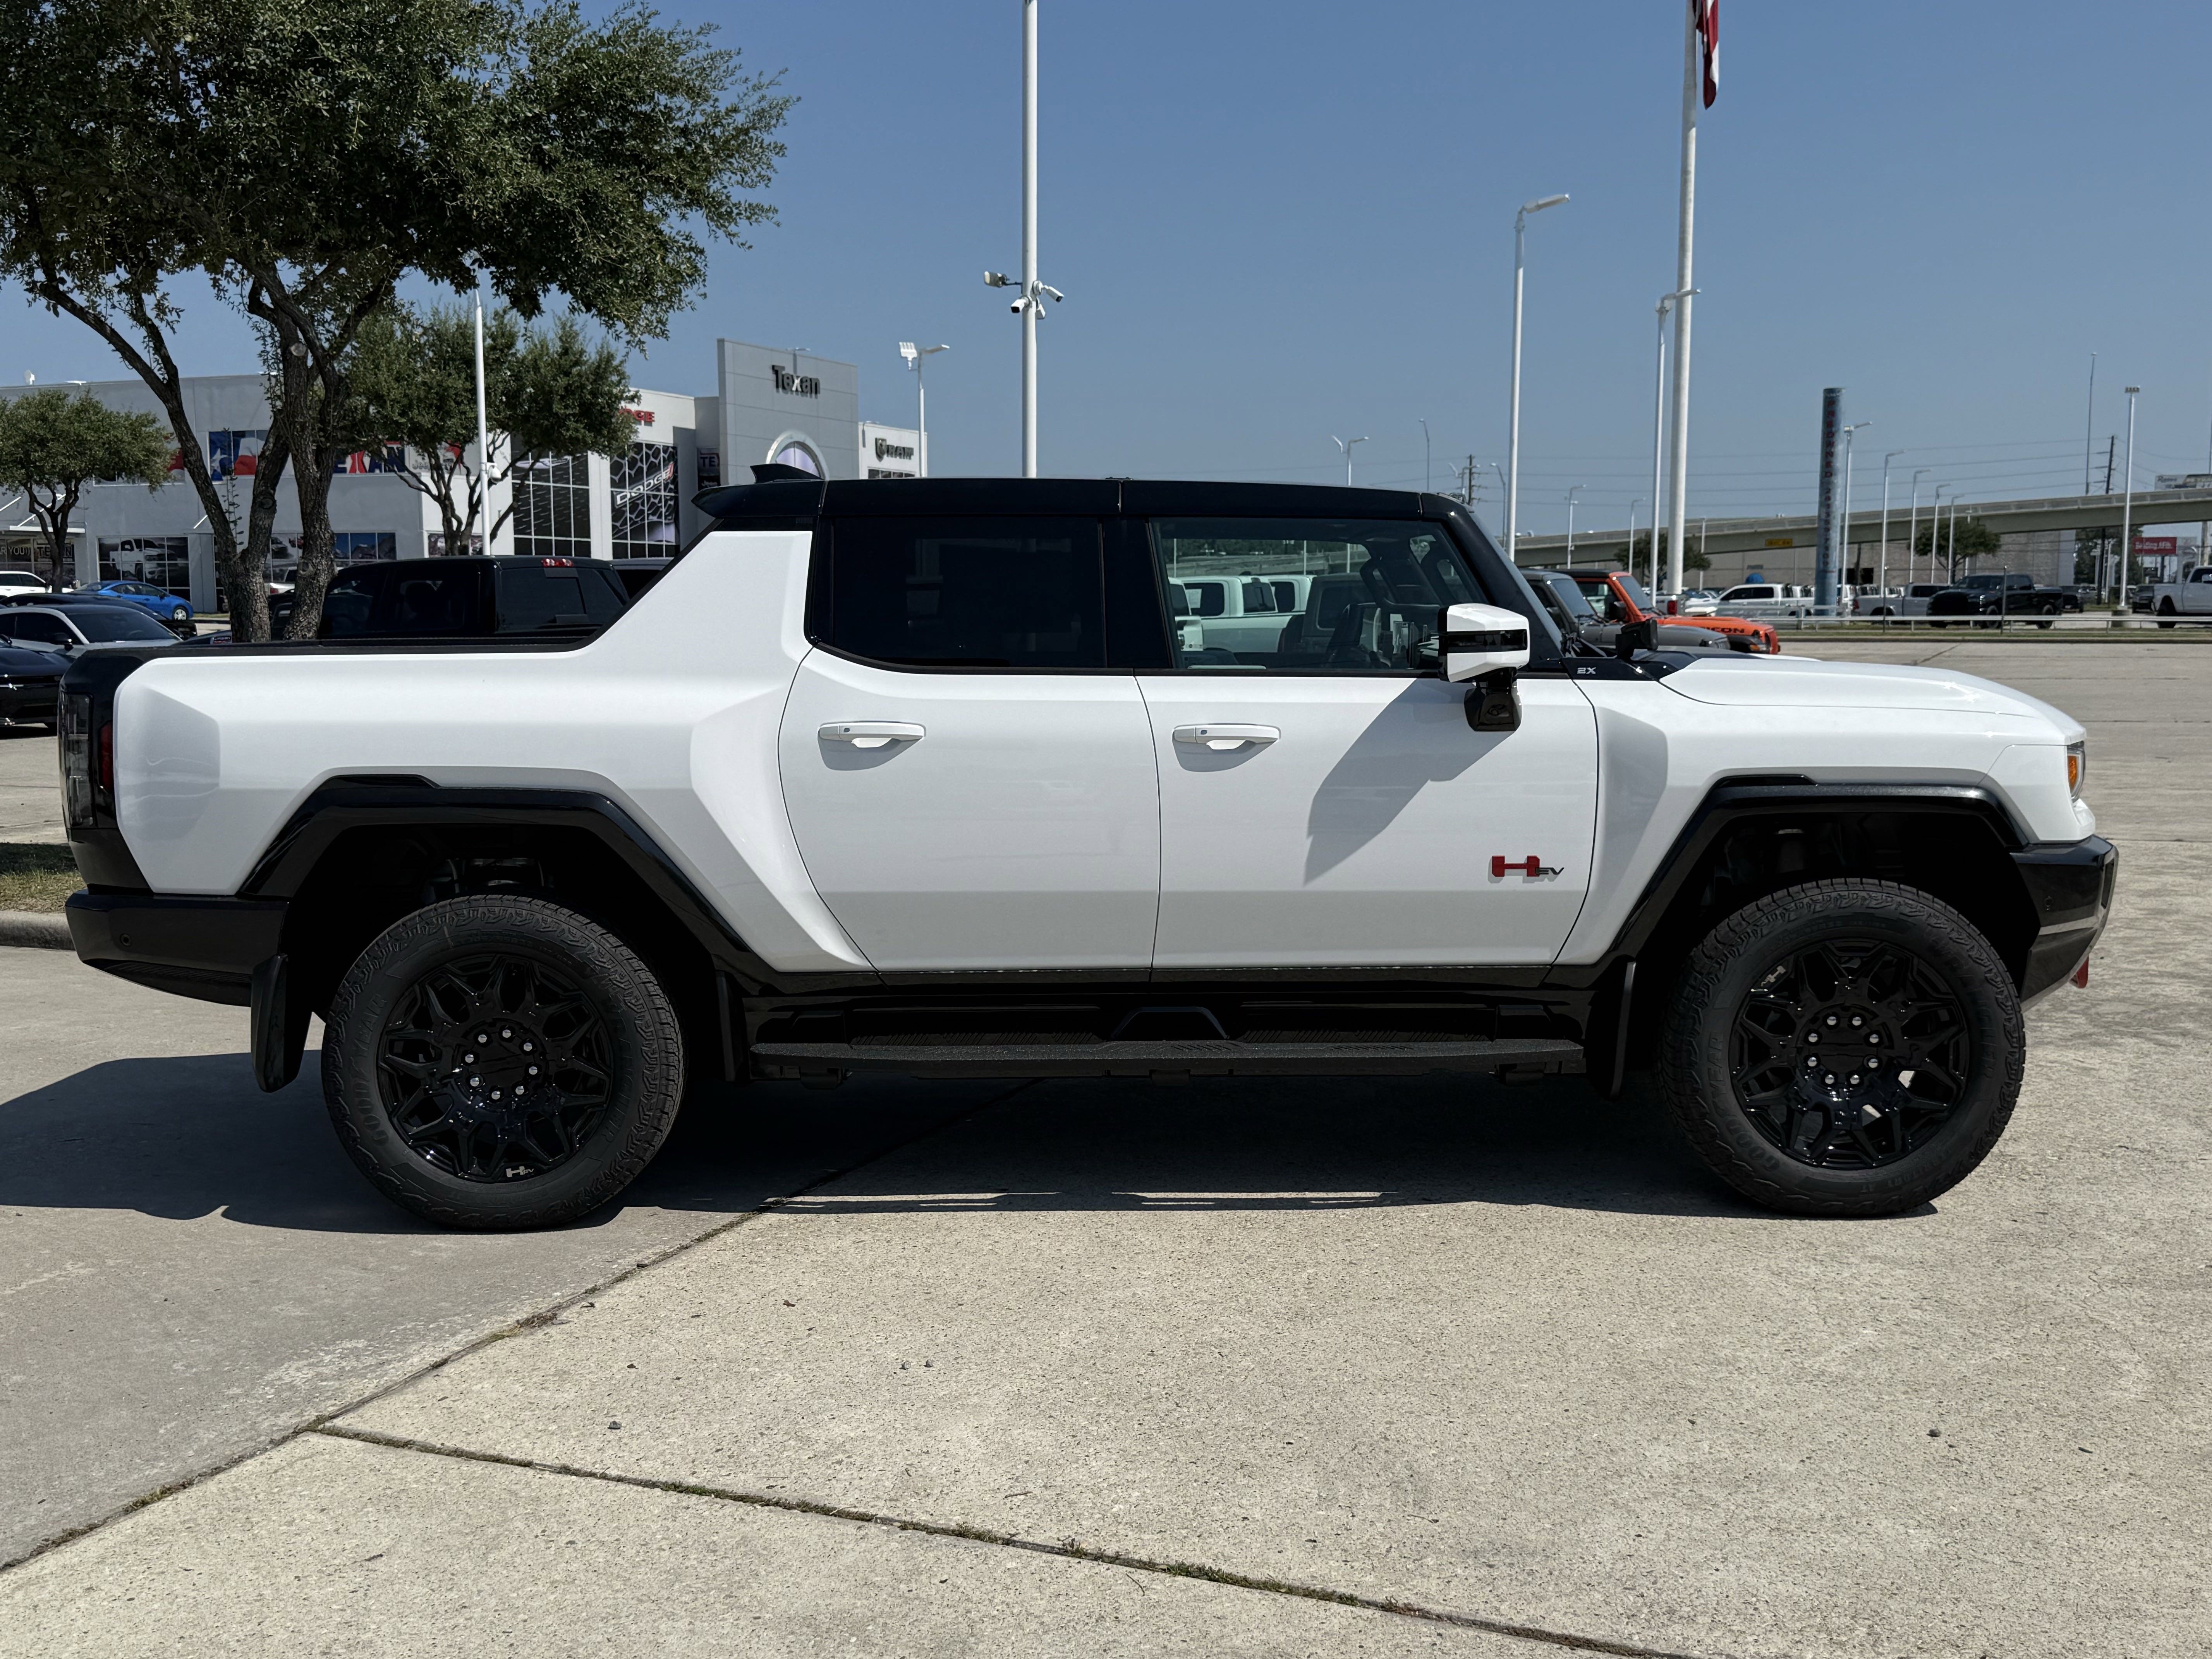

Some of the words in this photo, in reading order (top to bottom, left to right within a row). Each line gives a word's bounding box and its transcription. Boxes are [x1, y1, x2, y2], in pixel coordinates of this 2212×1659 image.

[772, 365, 820, 395] Texan
[886, 445, 914, 458] RAM
[617, 469, 670, 505] DODGE
